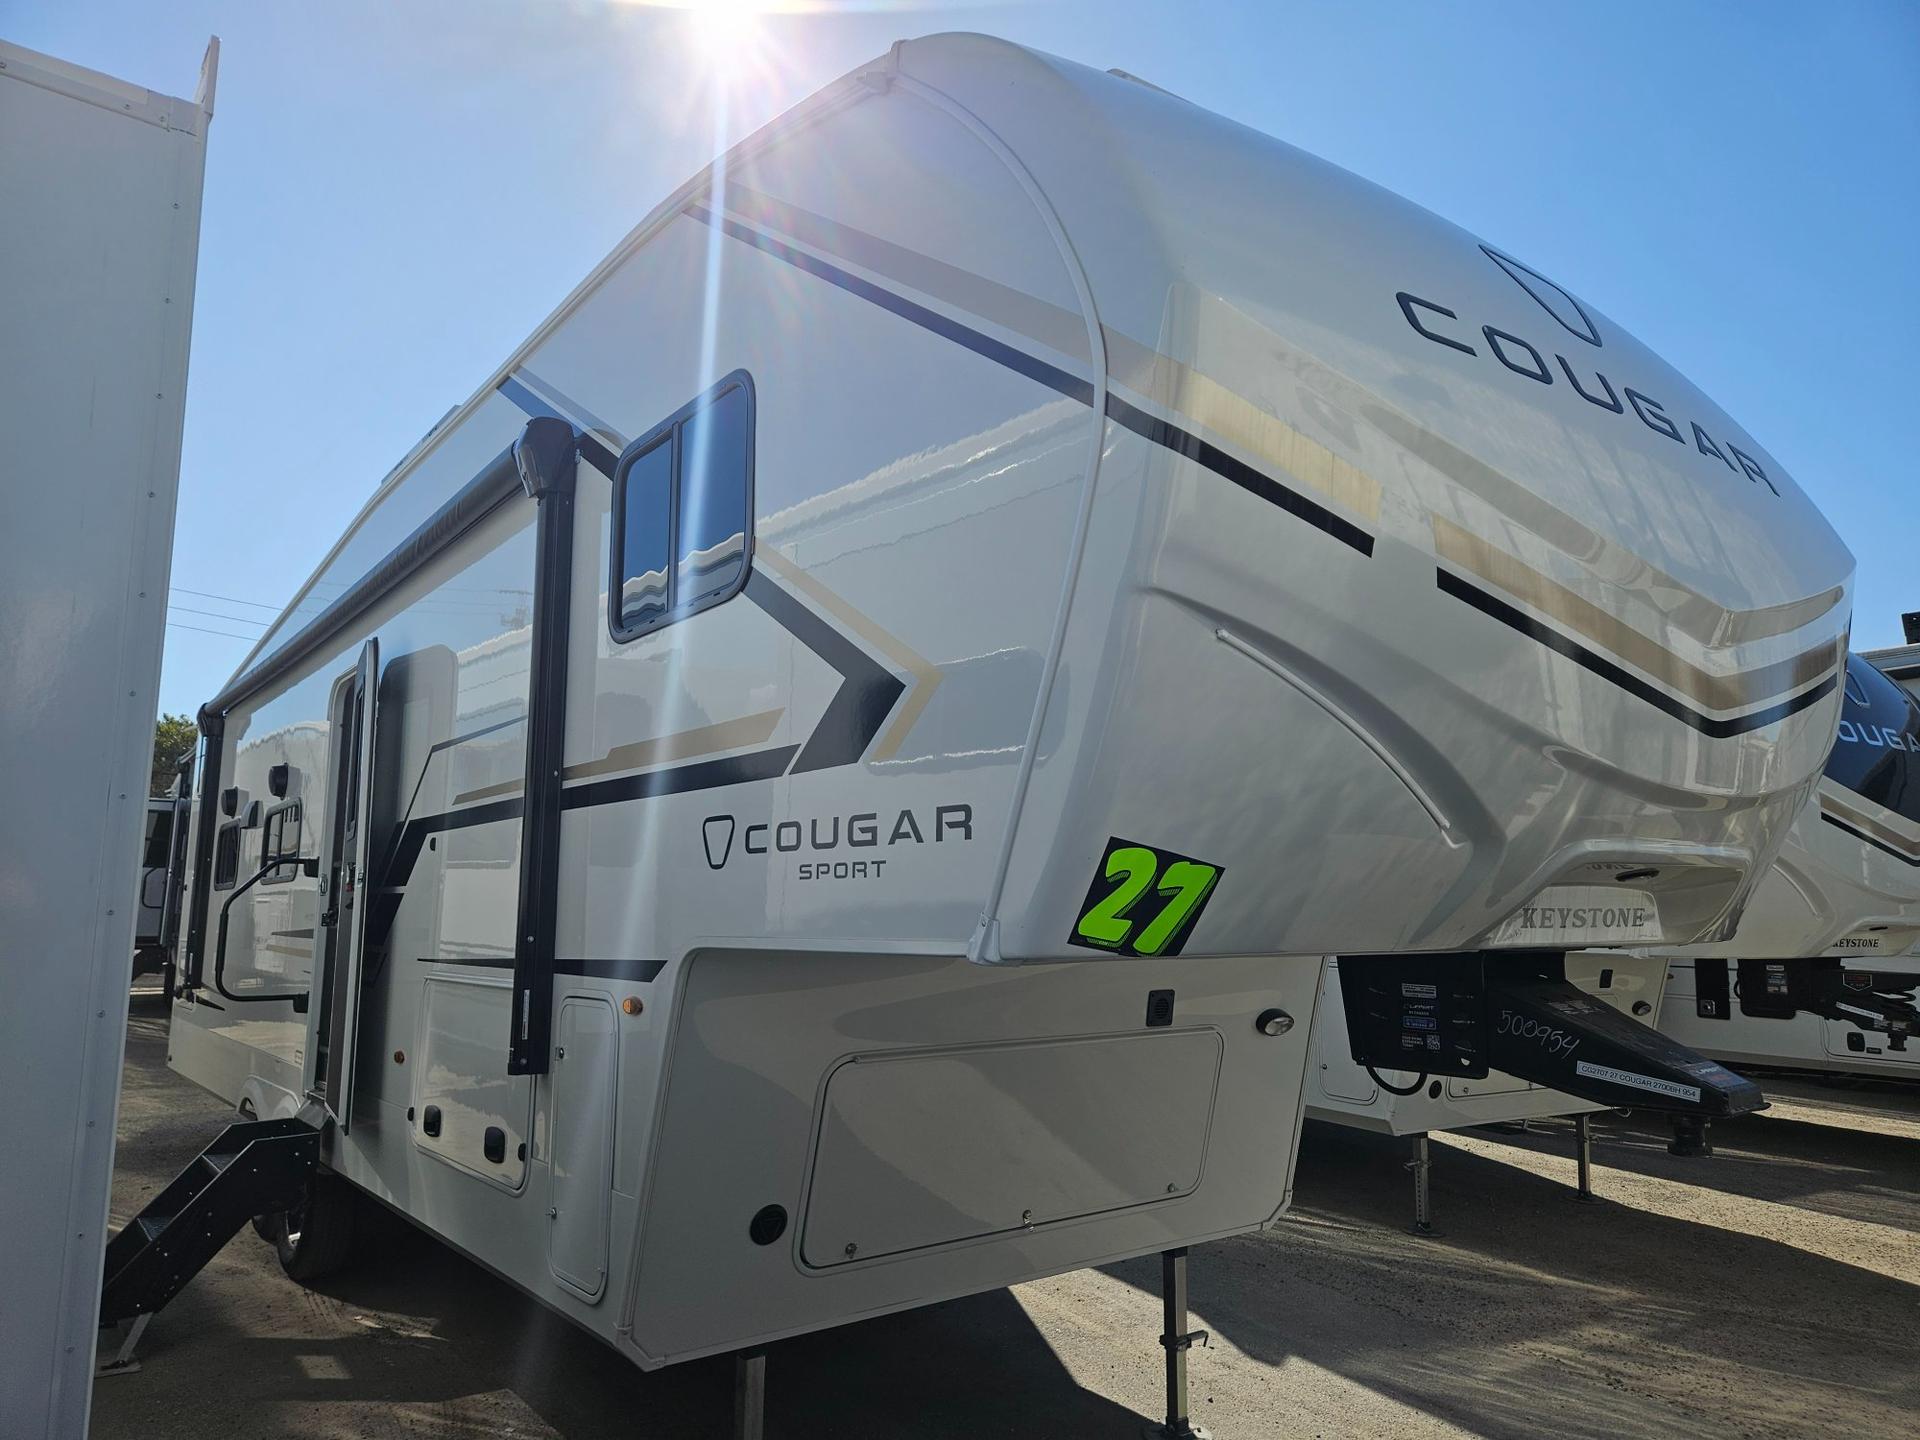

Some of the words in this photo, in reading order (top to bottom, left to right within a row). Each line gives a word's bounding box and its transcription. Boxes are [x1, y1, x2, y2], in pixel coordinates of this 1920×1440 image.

[1396, 291, 1781, 498] COUGAR
[1838, 720, 1920, 753] OUGA
[745, 803, 973, 854] COUGAR
[799, 860, 887, 880] SPORT
[1520, 907, 1646, 929] KEYSTONE
[1497, 1010, 1580, 1059] 500954
[1619, 1071, 1653, 1088] COUGAR
[1682, 1088, 1696, 1097] 954
